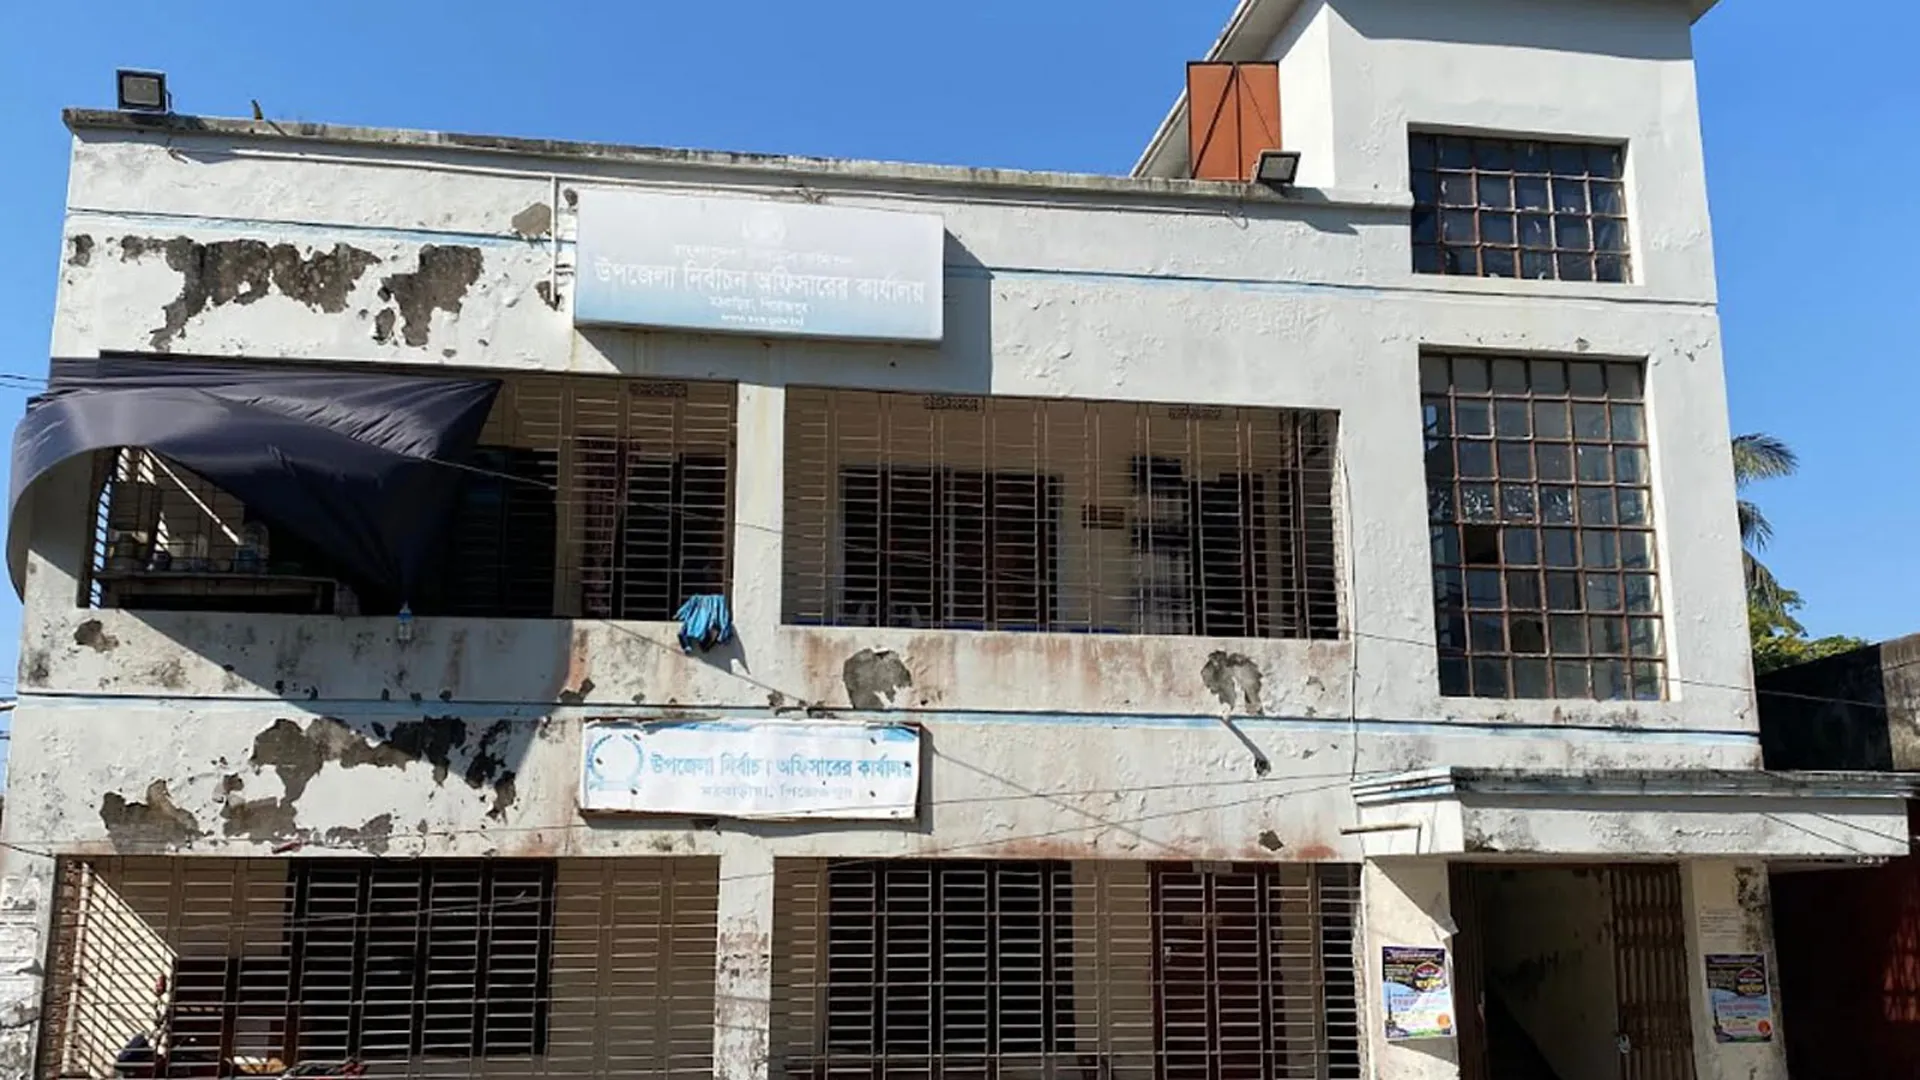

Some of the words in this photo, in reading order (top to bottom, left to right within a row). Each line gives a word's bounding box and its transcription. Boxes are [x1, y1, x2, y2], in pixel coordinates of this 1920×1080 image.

[594, 255, 677, 288] উপজেলা
[683, 257, 748, 295] নির্বাচন
[753, 265, 848, 300] অফিসারের
[855, 271, 925, 304] কার্যালয়
[650, 752, 714, 776] উপজেলা
[777, 752, 852, 777] অফিসারের
